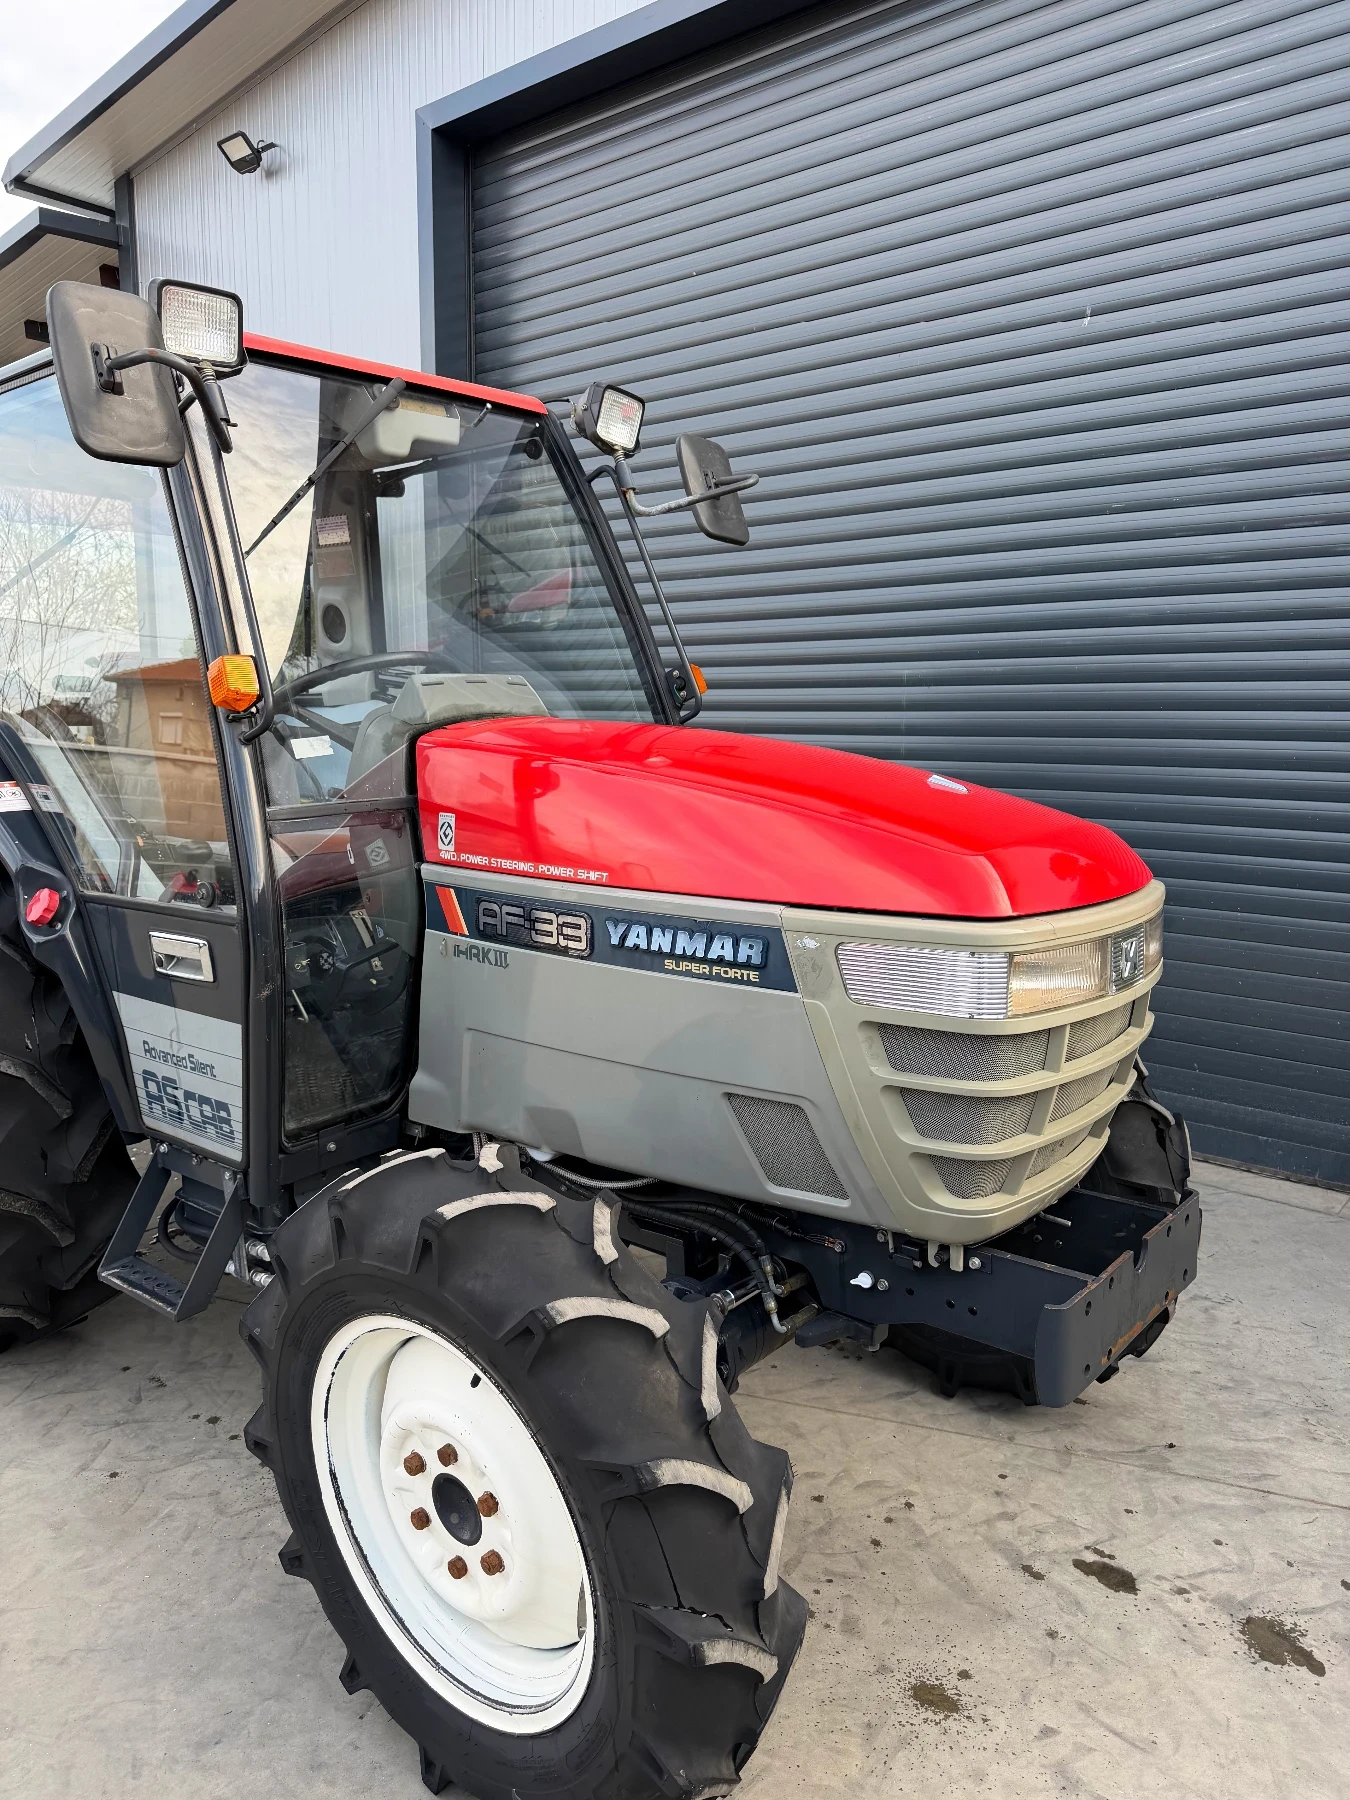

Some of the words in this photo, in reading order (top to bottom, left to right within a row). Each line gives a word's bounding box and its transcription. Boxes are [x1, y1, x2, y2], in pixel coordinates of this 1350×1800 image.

[577, 869, 609, 883] SHIFT
[605, 919, 765, 966] YANMAR
[664, 959, 710, 976] SUPER
[712, 965, 760, 982] FORTE
[142, 1040, 188, 1070] Advanced
[187, 1053, 217, 1078] Silent
